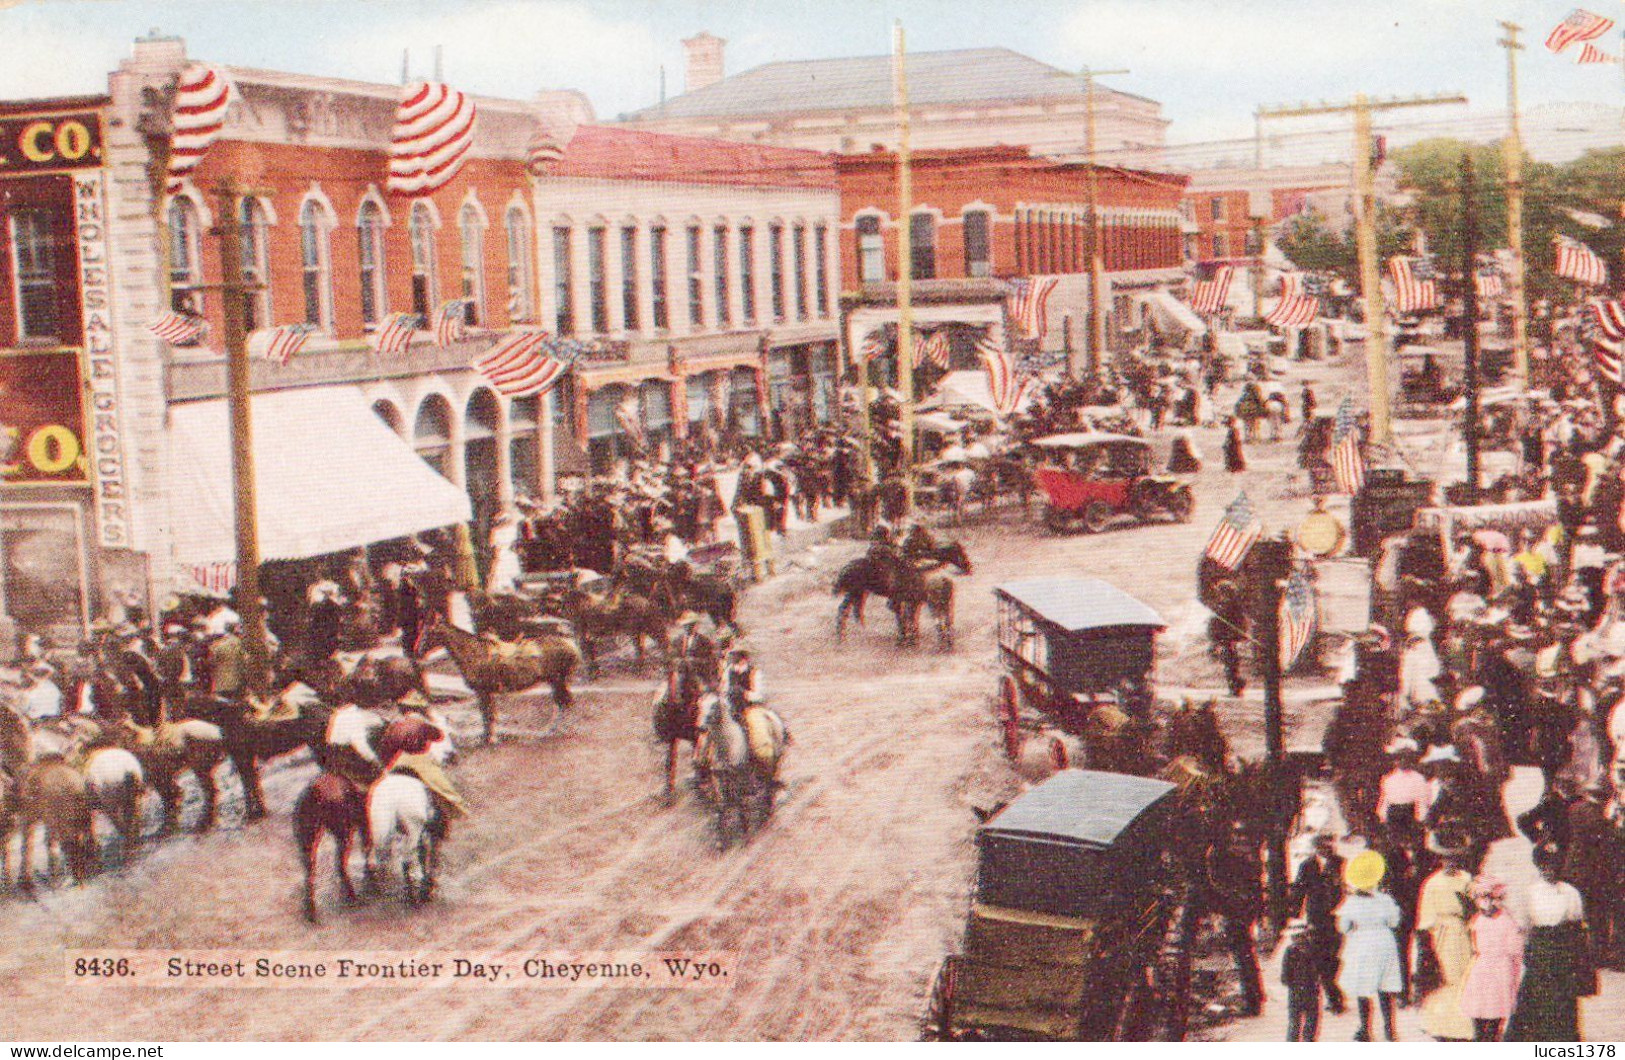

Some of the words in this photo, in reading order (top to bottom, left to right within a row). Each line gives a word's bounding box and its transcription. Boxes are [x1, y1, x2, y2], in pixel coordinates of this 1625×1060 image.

[19, 119, 101, 162] CO.
[75, 178, 114, 381] WHOLESALE
[94, 392, 128, 543] GROCERS
